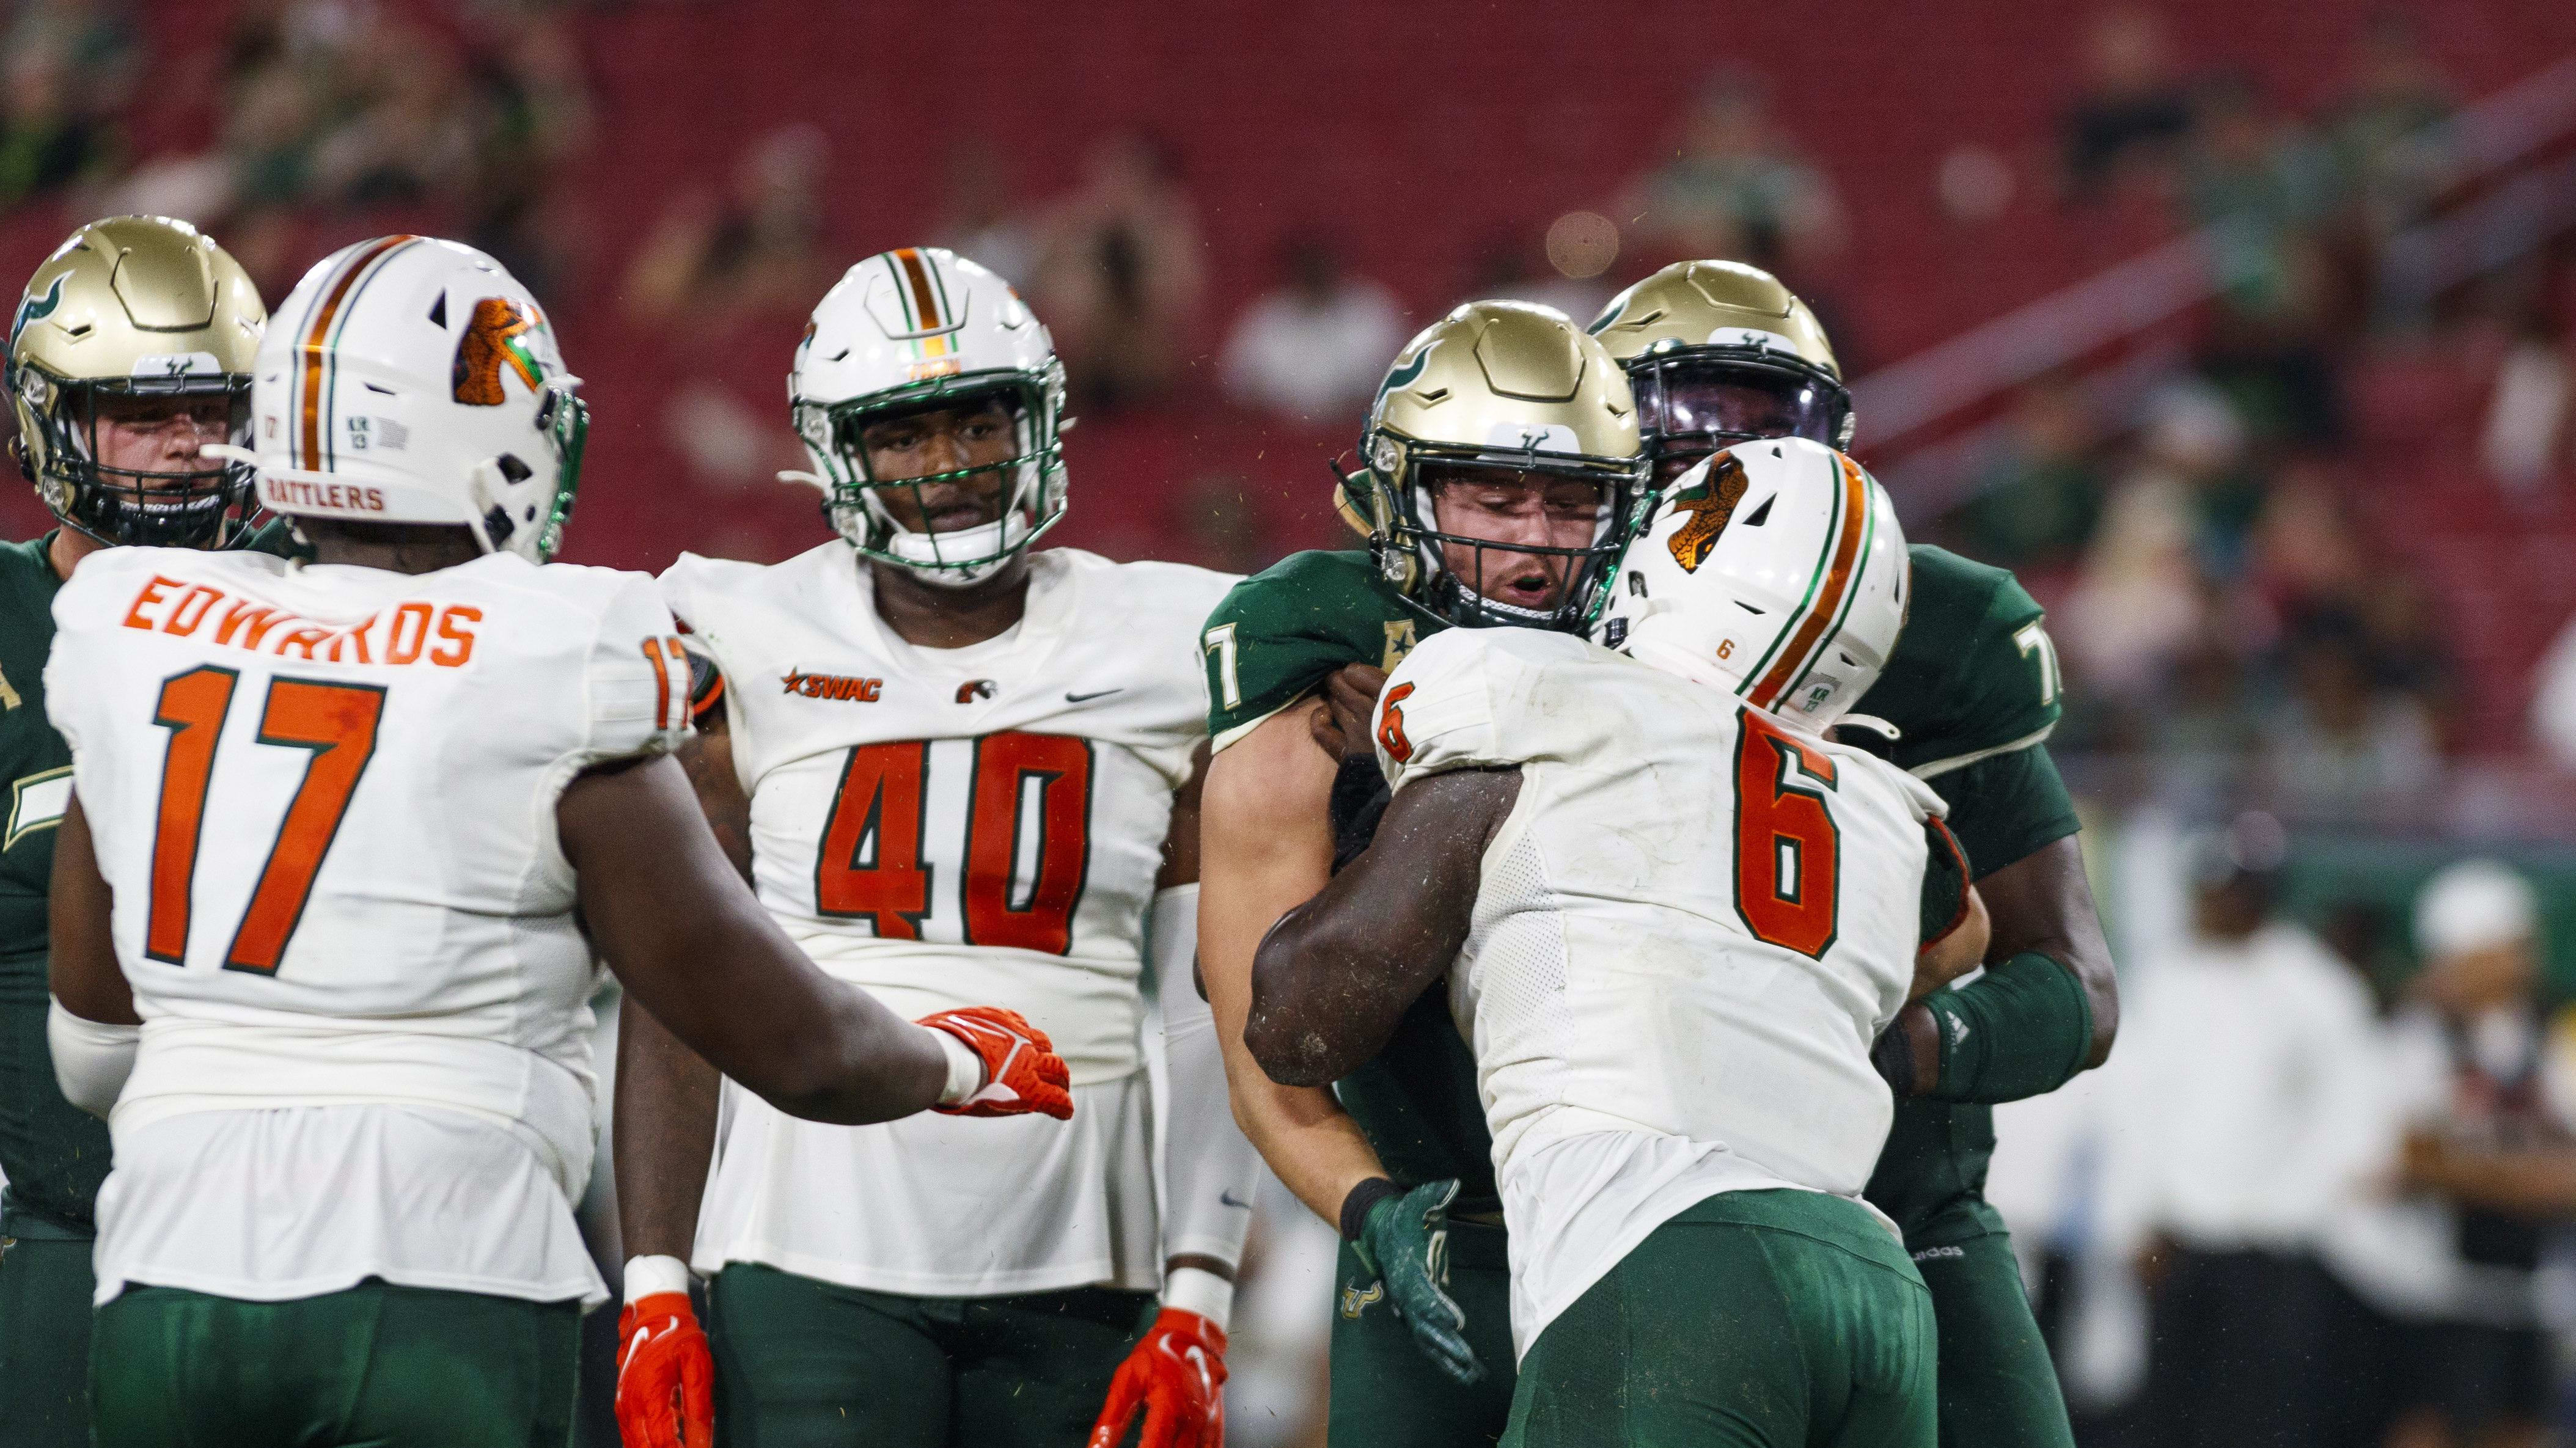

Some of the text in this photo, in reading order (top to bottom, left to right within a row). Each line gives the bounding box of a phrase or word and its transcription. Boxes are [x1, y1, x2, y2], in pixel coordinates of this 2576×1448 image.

[121, 573, 483, 667] EDWARDS
[1716, 638, 1735, 660] 6
[2013, 619, 2064, 706] 7
[805, 674, 884, 702] SWAC
[1378, 681, 1416, 764] 6
[144, 663, 388, 977] 17
[814, 731, 1096, 957] 40
[1732, 704, 1841, 962] 6
